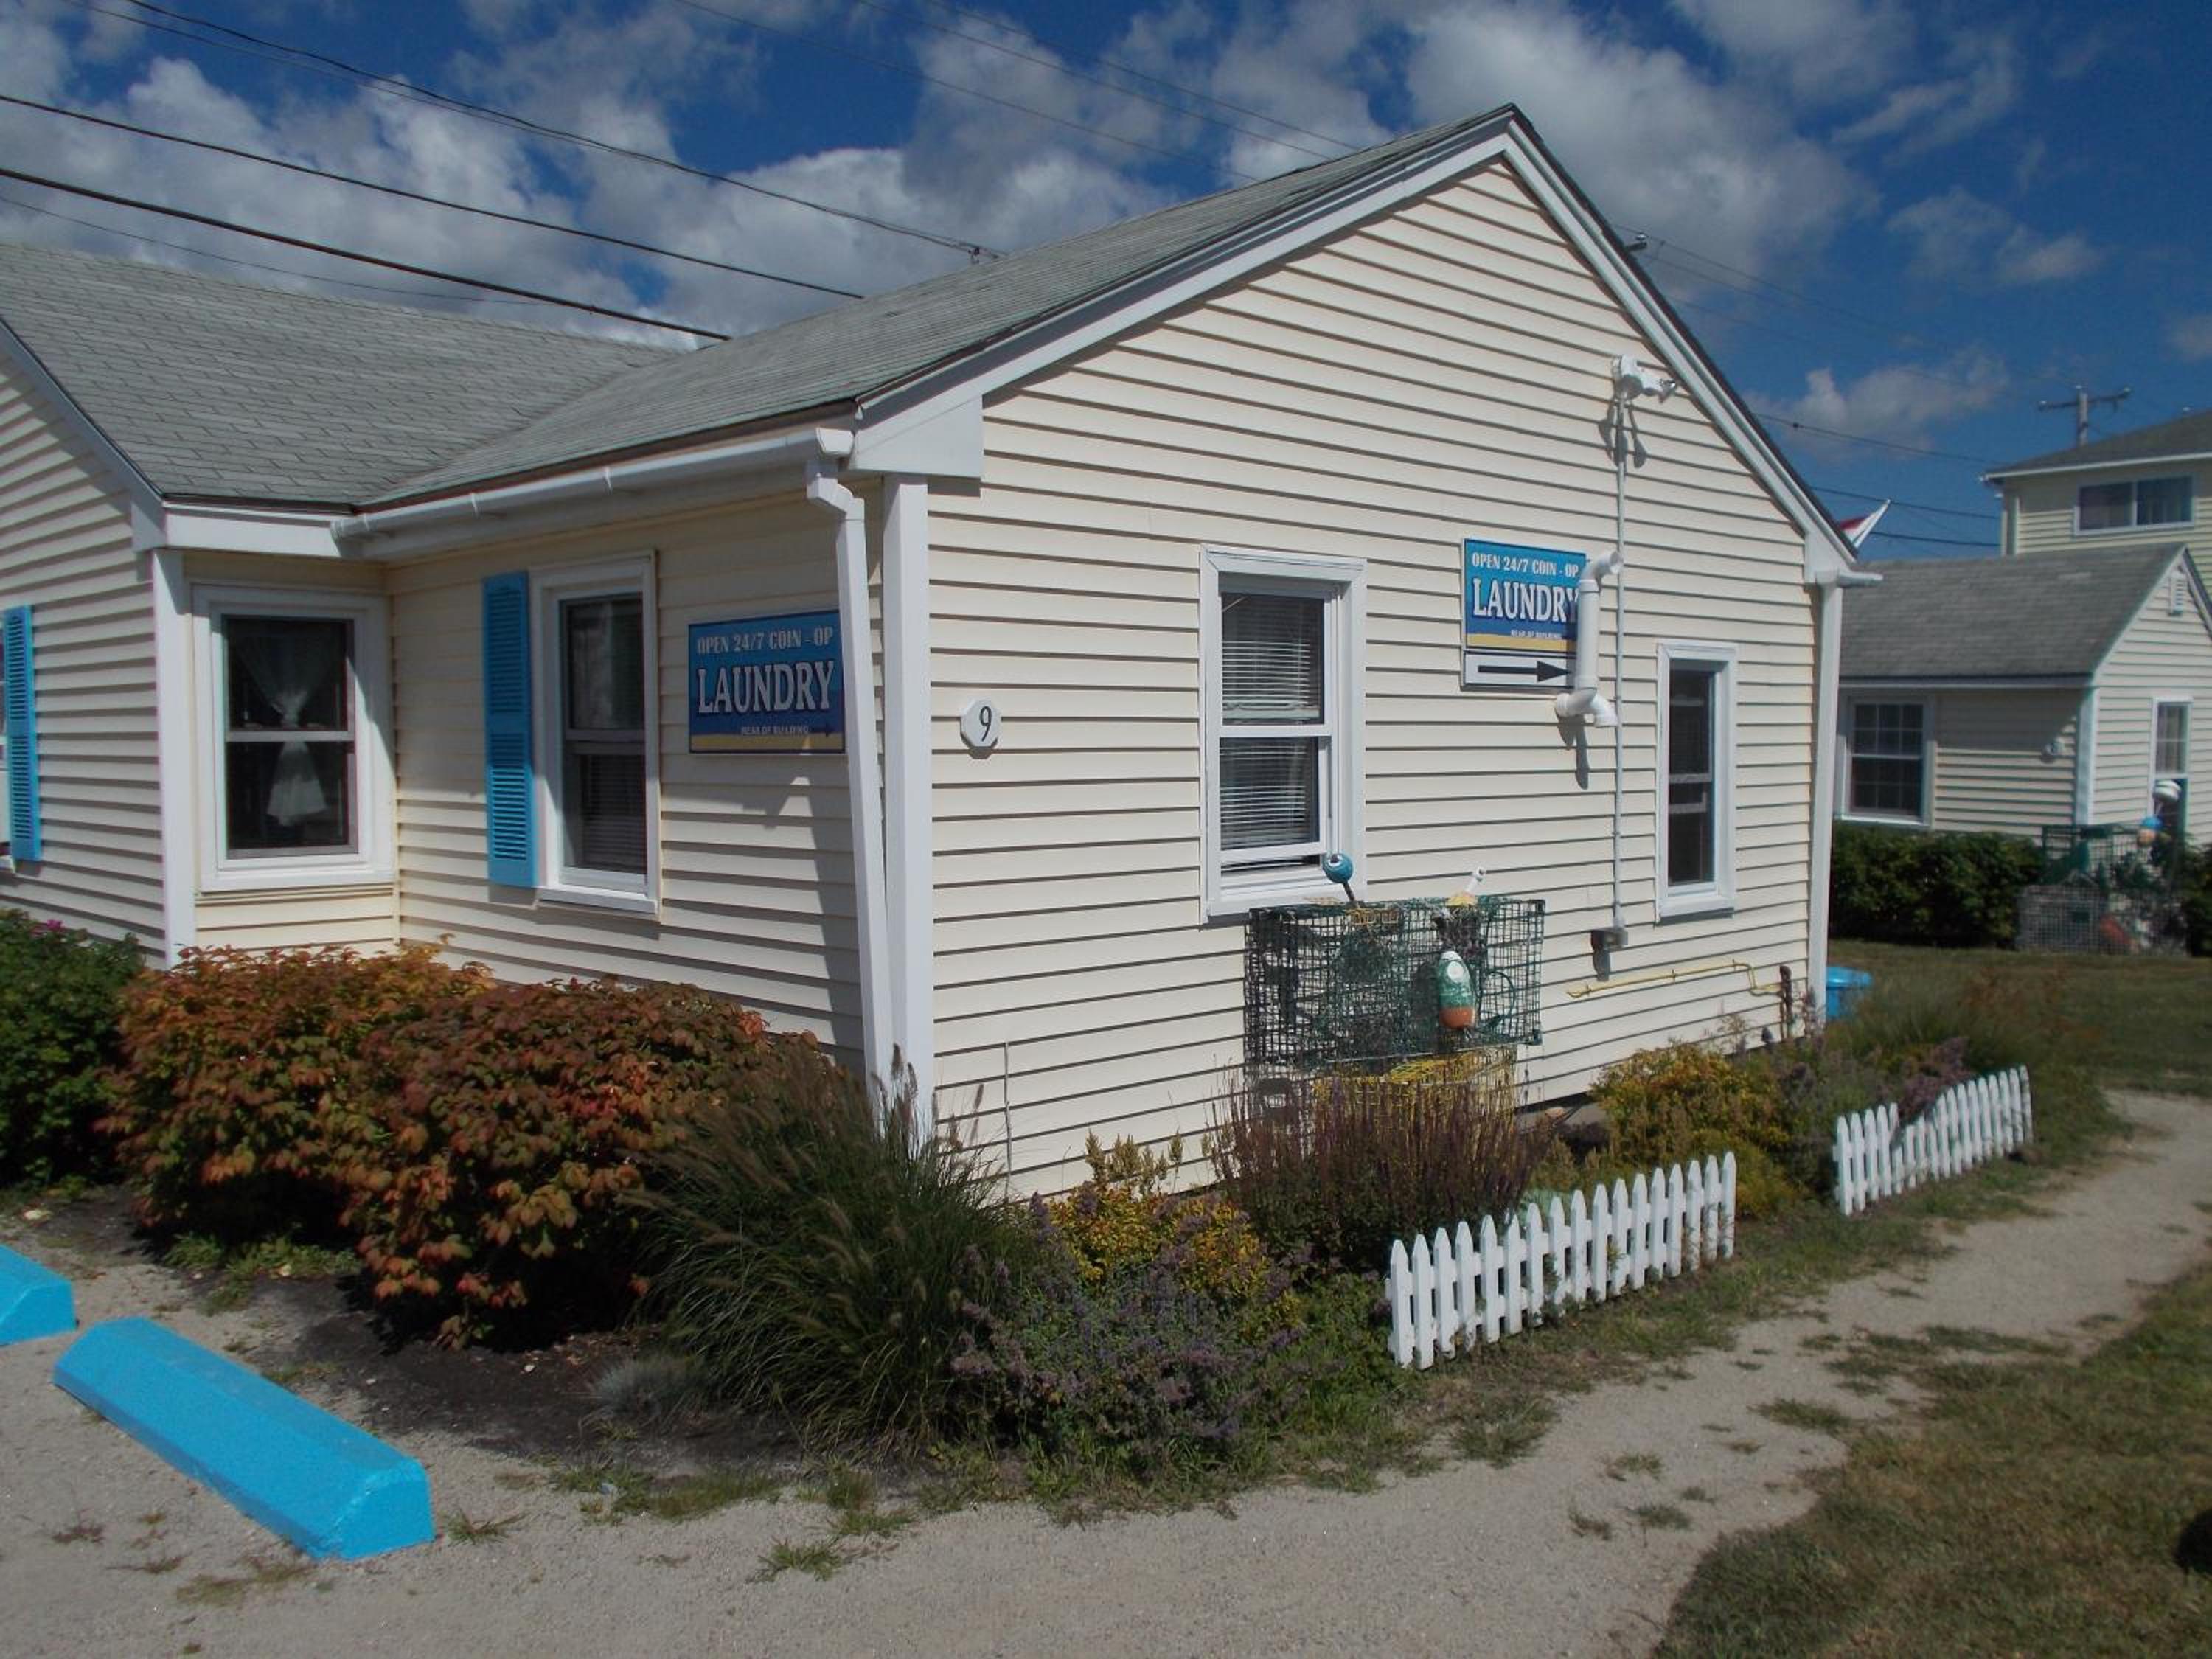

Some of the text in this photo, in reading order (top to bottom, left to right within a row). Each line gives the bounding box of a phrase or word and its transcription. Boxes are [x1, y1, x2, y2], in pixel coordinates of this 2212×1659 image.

[1472, 552, 1500, 569] OPEN
[1503, 556, 1528, 572] 24/7
[1531, 559, 1557, 575] COIN
[1565, 563, 1579, 577] OP
[1472, 577, 1579, 622] LAUNDRY
[697, 636, 729, 655] OPEN
[734, 632, 765, 652] 24/7
[768, 628, 801, 650] COIN
[813, 626, 833, 647] OP
[698, 660, 834, 713] LAUNDRY
[979, 706, 992, 742] 9
